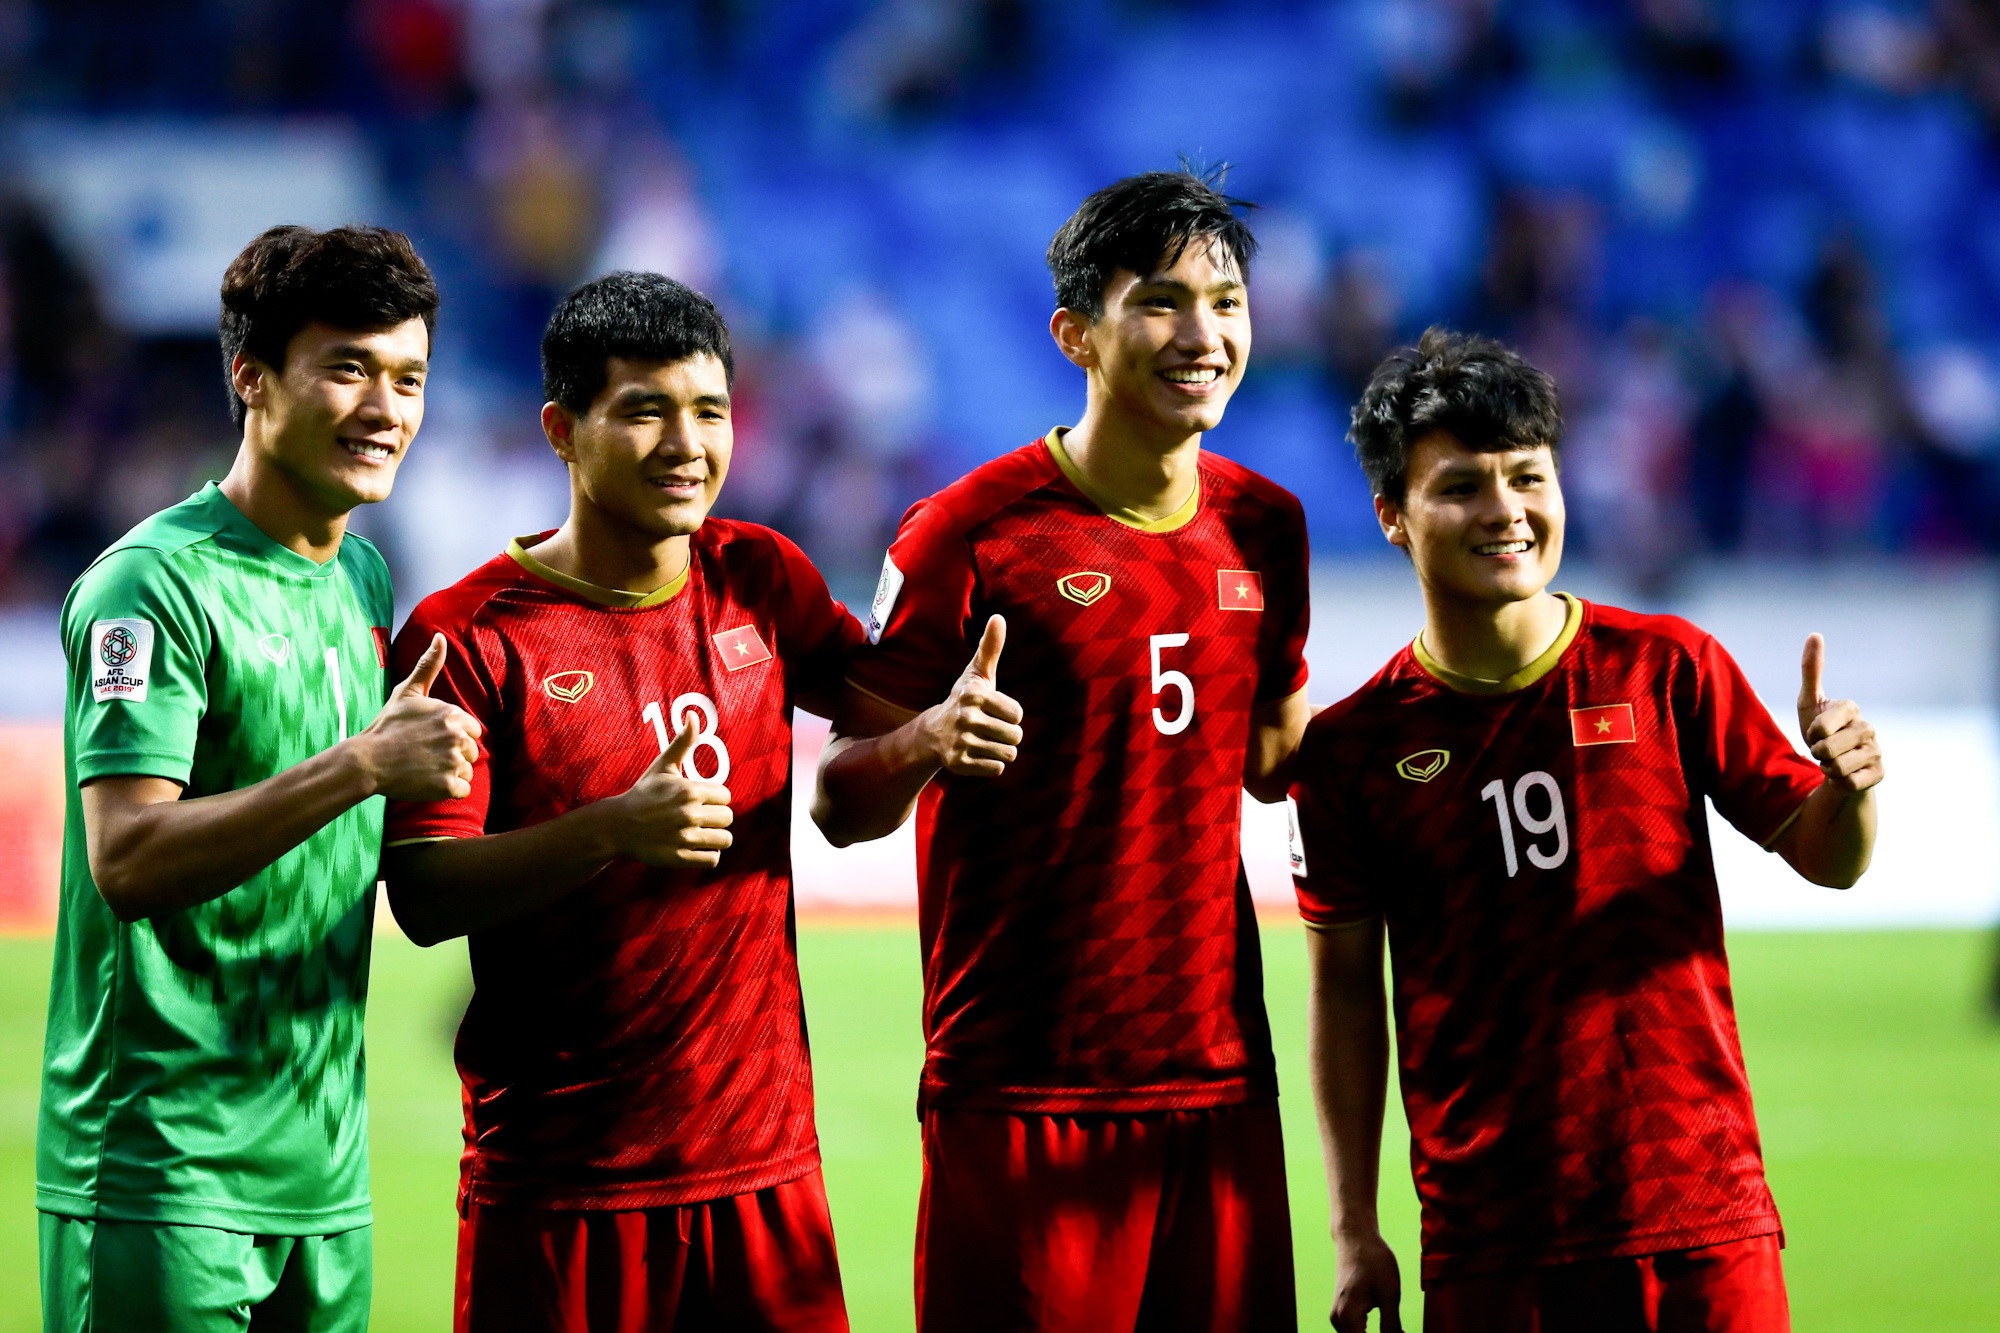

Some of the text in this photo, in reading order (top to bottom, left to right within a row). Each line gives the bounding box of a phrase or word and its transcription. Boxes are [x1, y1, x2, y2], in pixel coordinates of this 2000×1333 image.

[94, 676, 143, 688] ASIAN CUP
[100, 686, 111, 694] UAE
[107, 668, 124, 676] AFC
[324, 647, 347, 742] 1
[1149, 632, 1195, 735] 5
[642, 692, 731, 785] 18
[1481, 770, 1569, 878] 19
